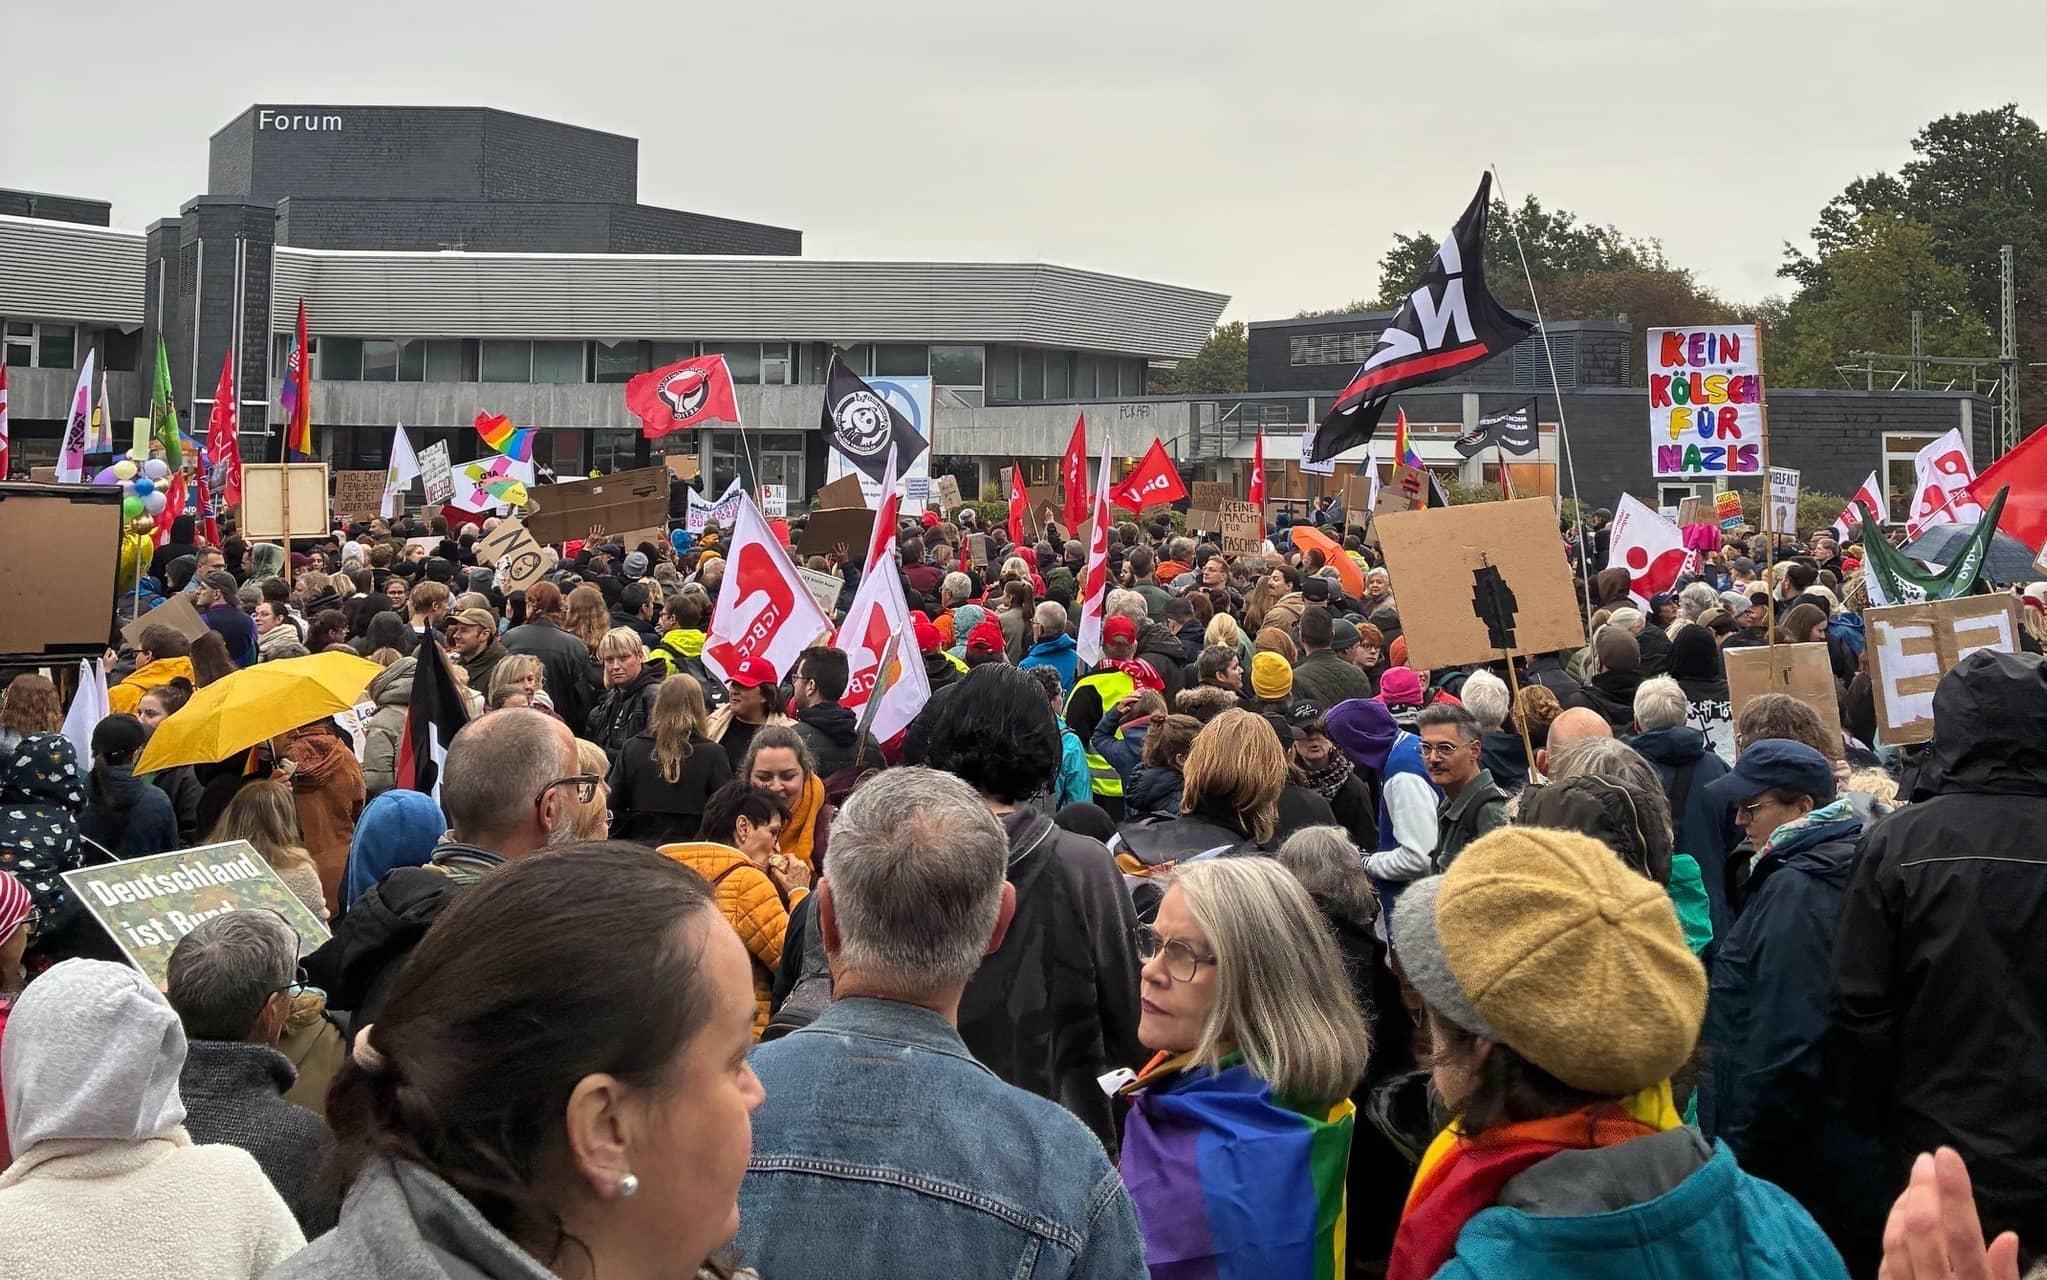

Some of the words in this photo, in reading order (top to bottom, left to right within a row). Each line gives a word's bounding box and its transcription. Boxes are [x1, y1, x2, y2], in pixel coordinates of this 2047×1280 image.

[259, 110, 342, 131] Forum
[1660, 333, 1741, 367] KEIN
[1650, 370, 1760, 408] KÖLSCH
[1669, 406, 1742, 441] FÜR
[1657, 444, 1760, 474] NAZIS
[1223, 513, 1257, 523] MACHT
[1224, 536, 1260, 553] FASCHOS
[87, 852, 262, 908] Deutschland
[121, 917, 175, 948] ist
